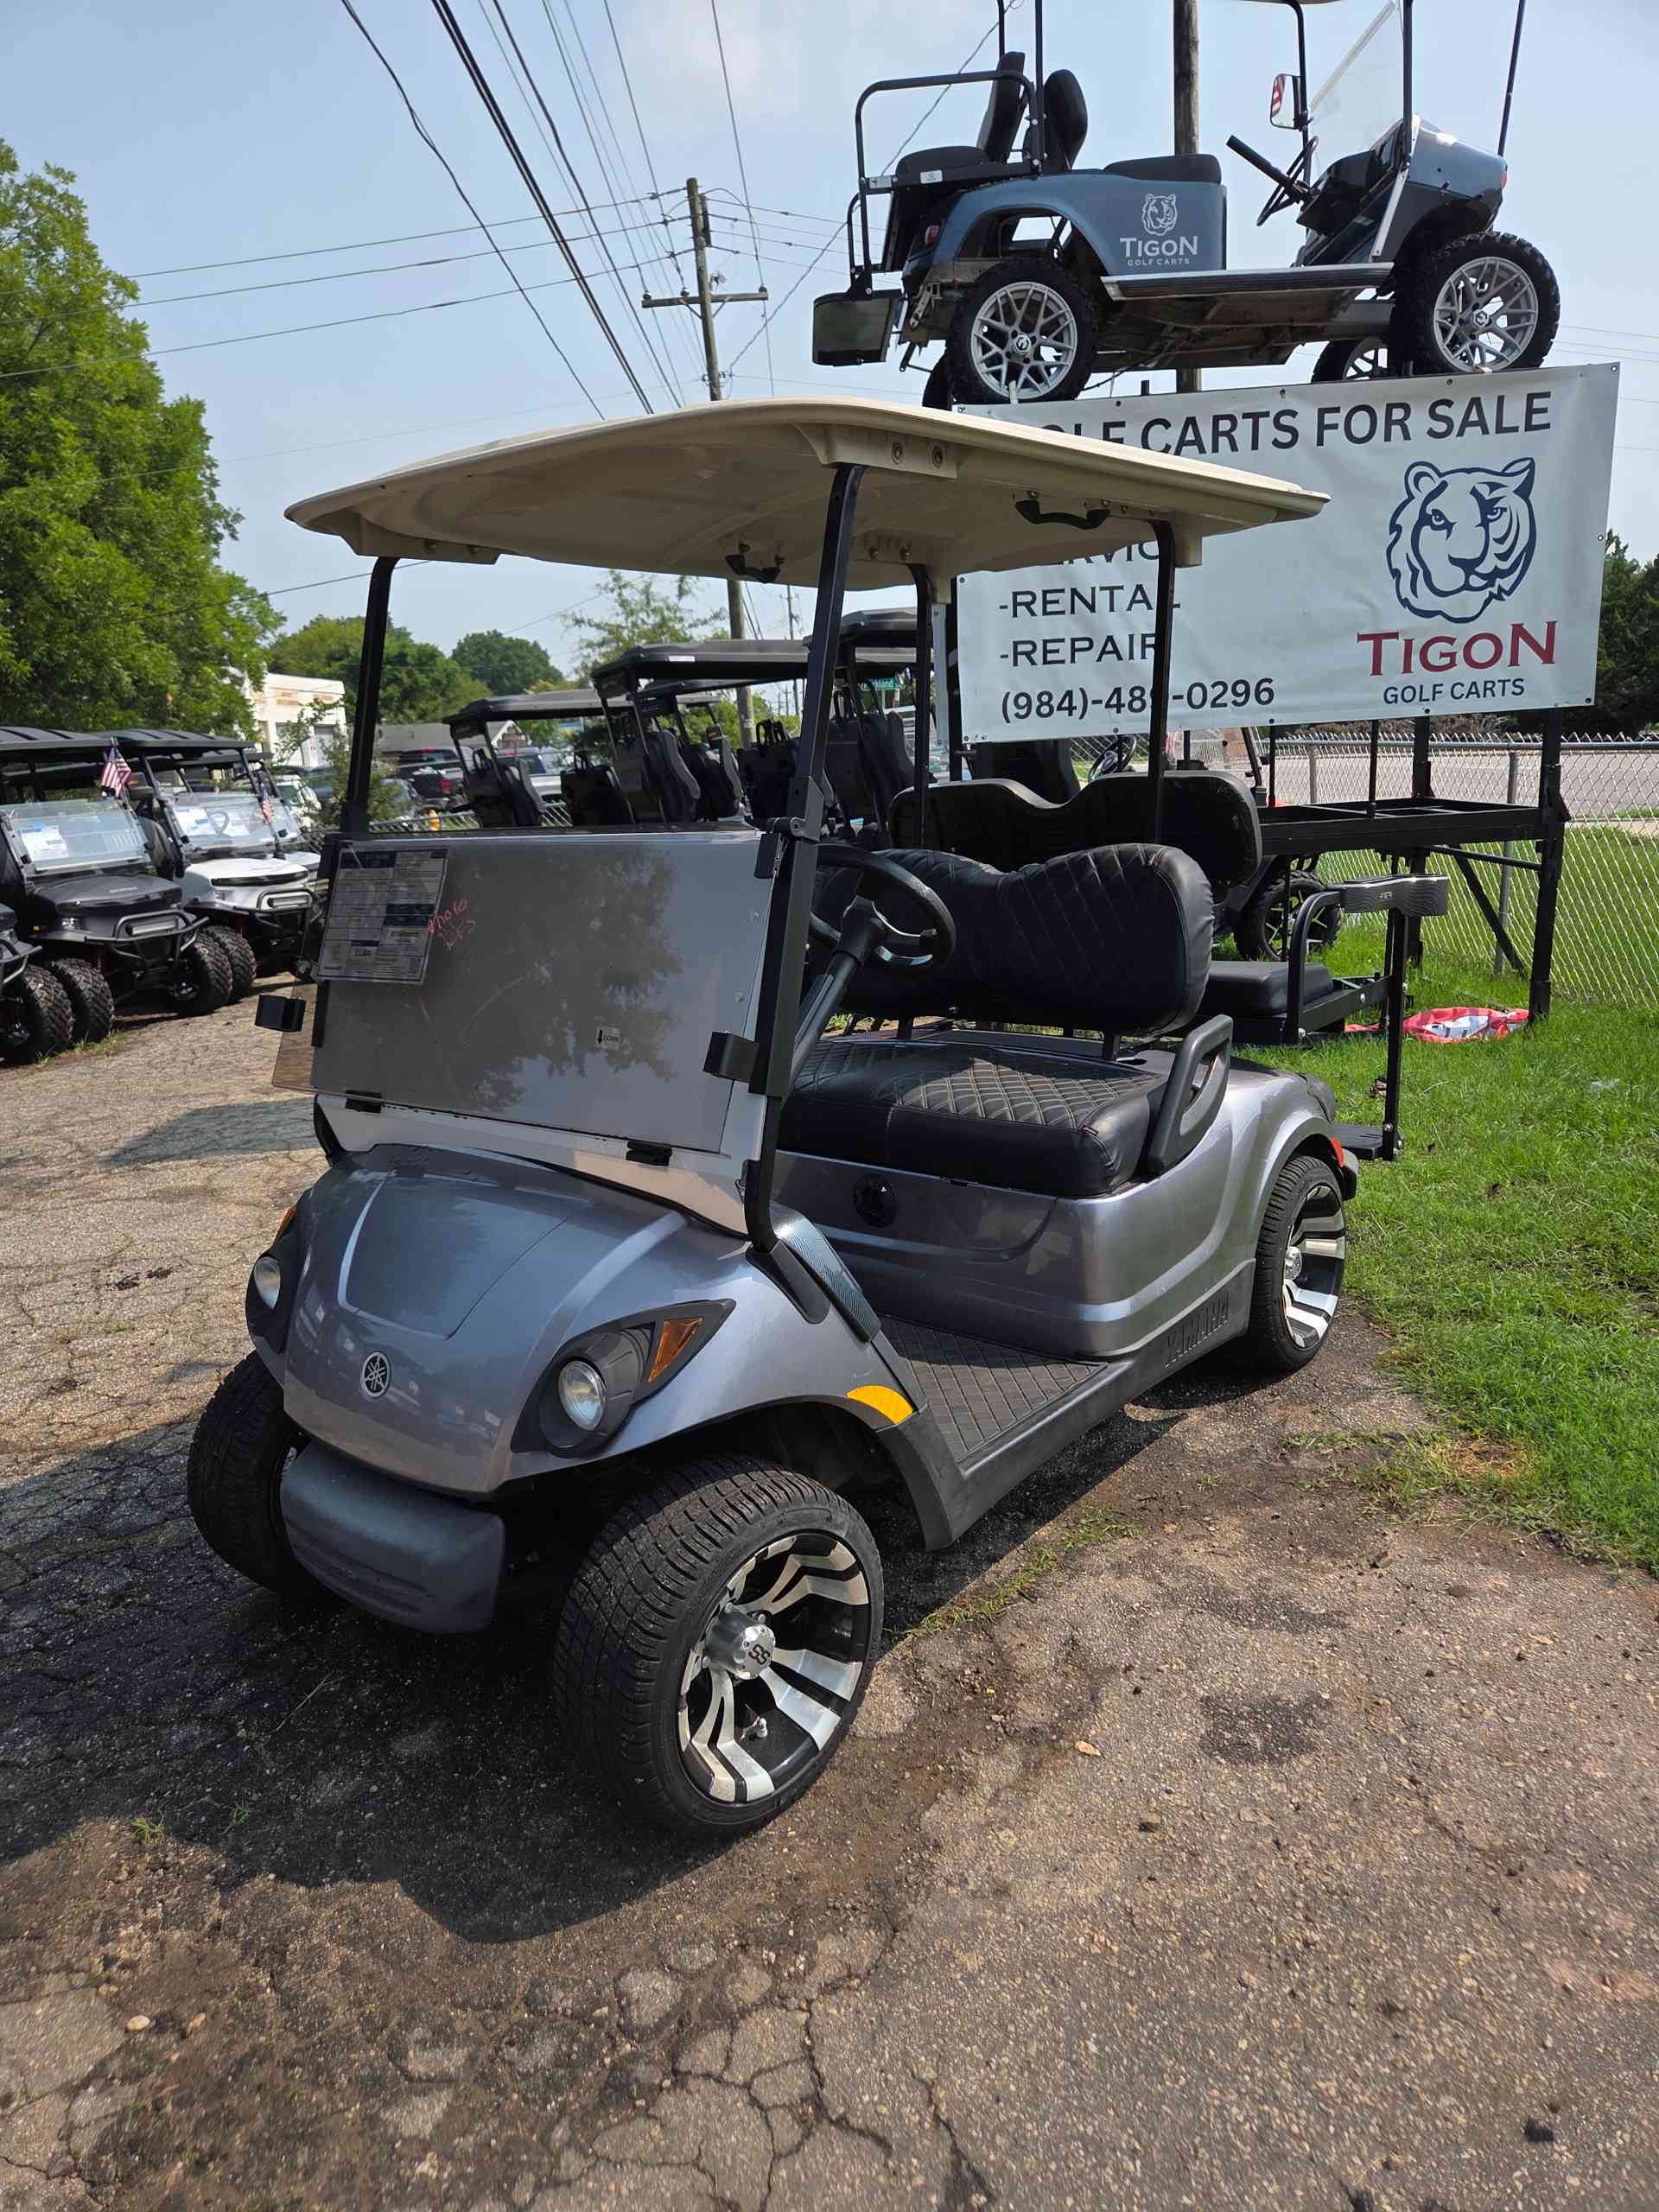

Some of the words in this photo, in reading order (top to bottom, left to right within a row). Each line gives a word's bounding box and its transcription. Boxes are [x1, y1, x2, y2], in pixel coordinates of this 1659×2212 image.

[1156, 257, 1191, 266] CARTS
[1141, 409, 1300, 455] CARTS
[1316, 402, 1412, 447] FOR
[1426, 391, 1552, 439] SALE
[999, 584, 1180, 618] -RENTA
[1001, 677, 1275, 723] (984)-48-0296
[1382, 683, 1445, 704] GOLF
[1449, 677, 1526, 700] CARTS
[748, 1643, 771, 1665] SS
